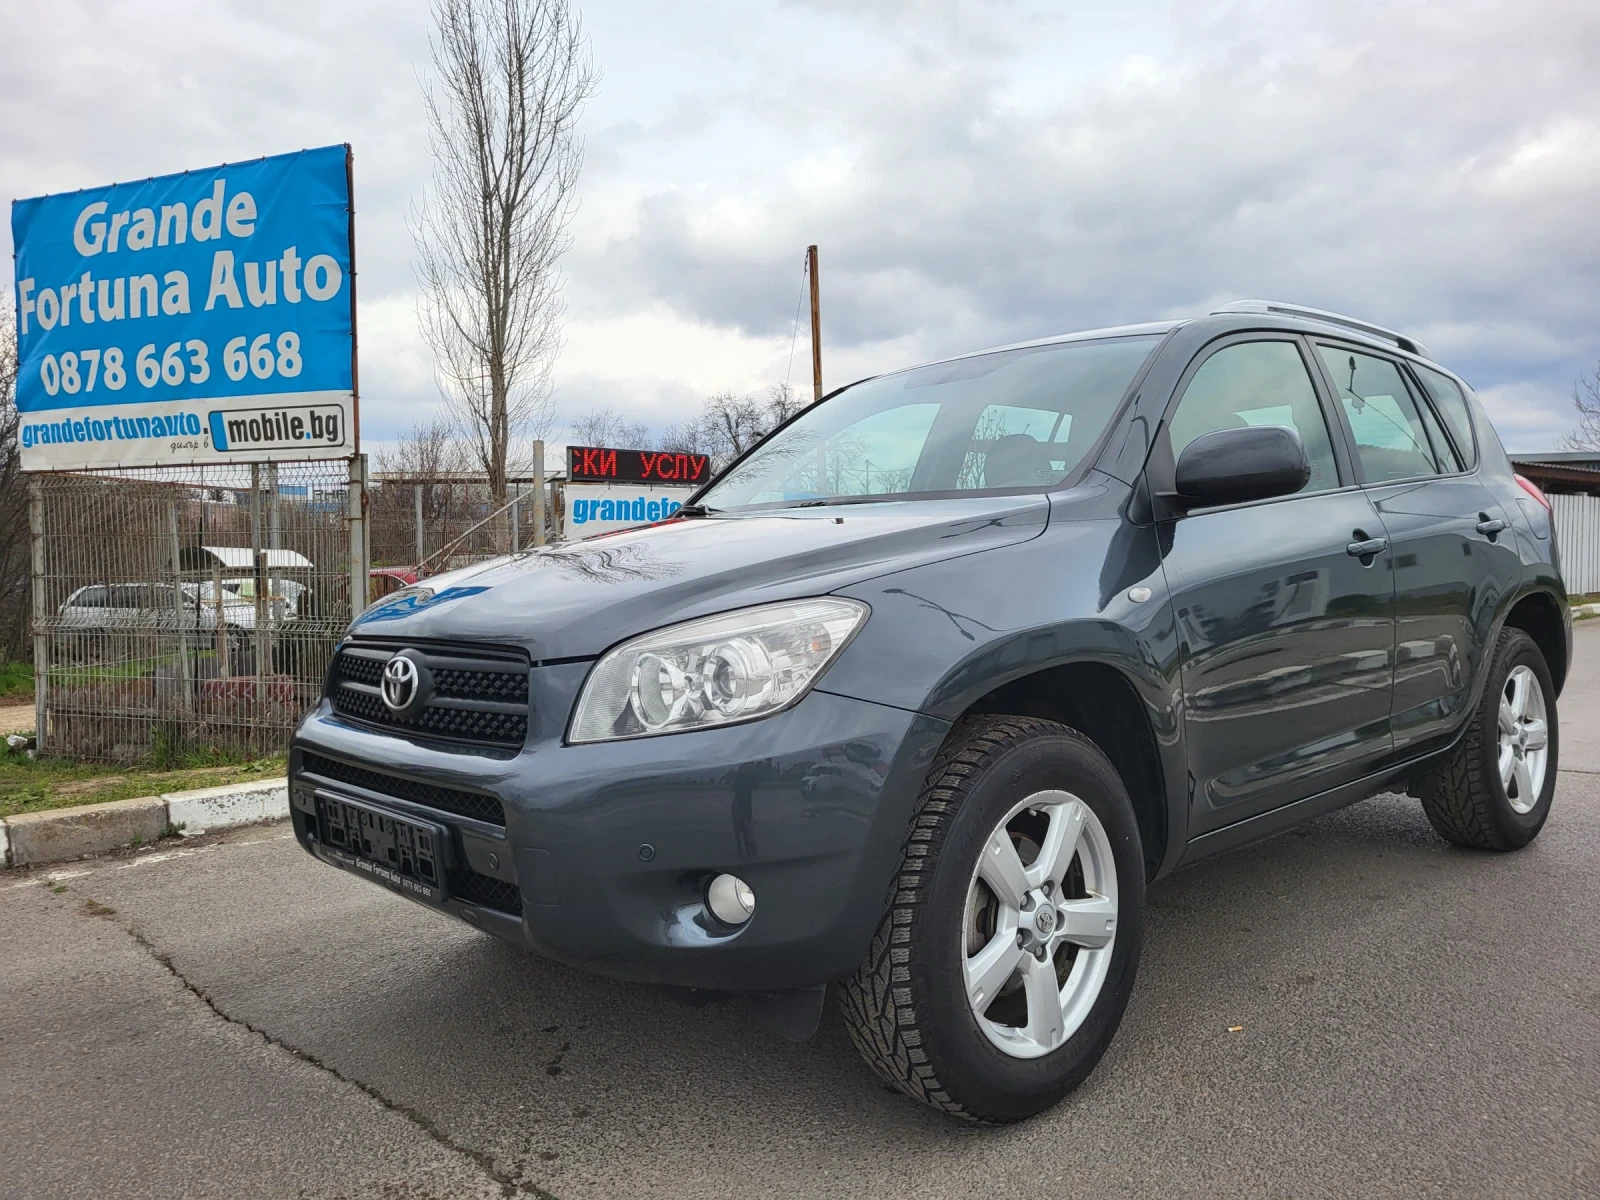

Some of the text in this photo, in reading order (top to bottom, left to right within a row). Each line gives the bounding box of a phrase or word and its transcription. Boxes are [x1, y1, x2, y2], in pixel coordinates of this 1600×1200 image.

[73, 179, 257, 257] Grande
[18, 246, 343, 335] Fortuna Auto
[40, 331, 303, 396] 0878 663 668
[227, 410, 339, 443] mobile.bg
[640, 452, 706, 480] УСЛУ
